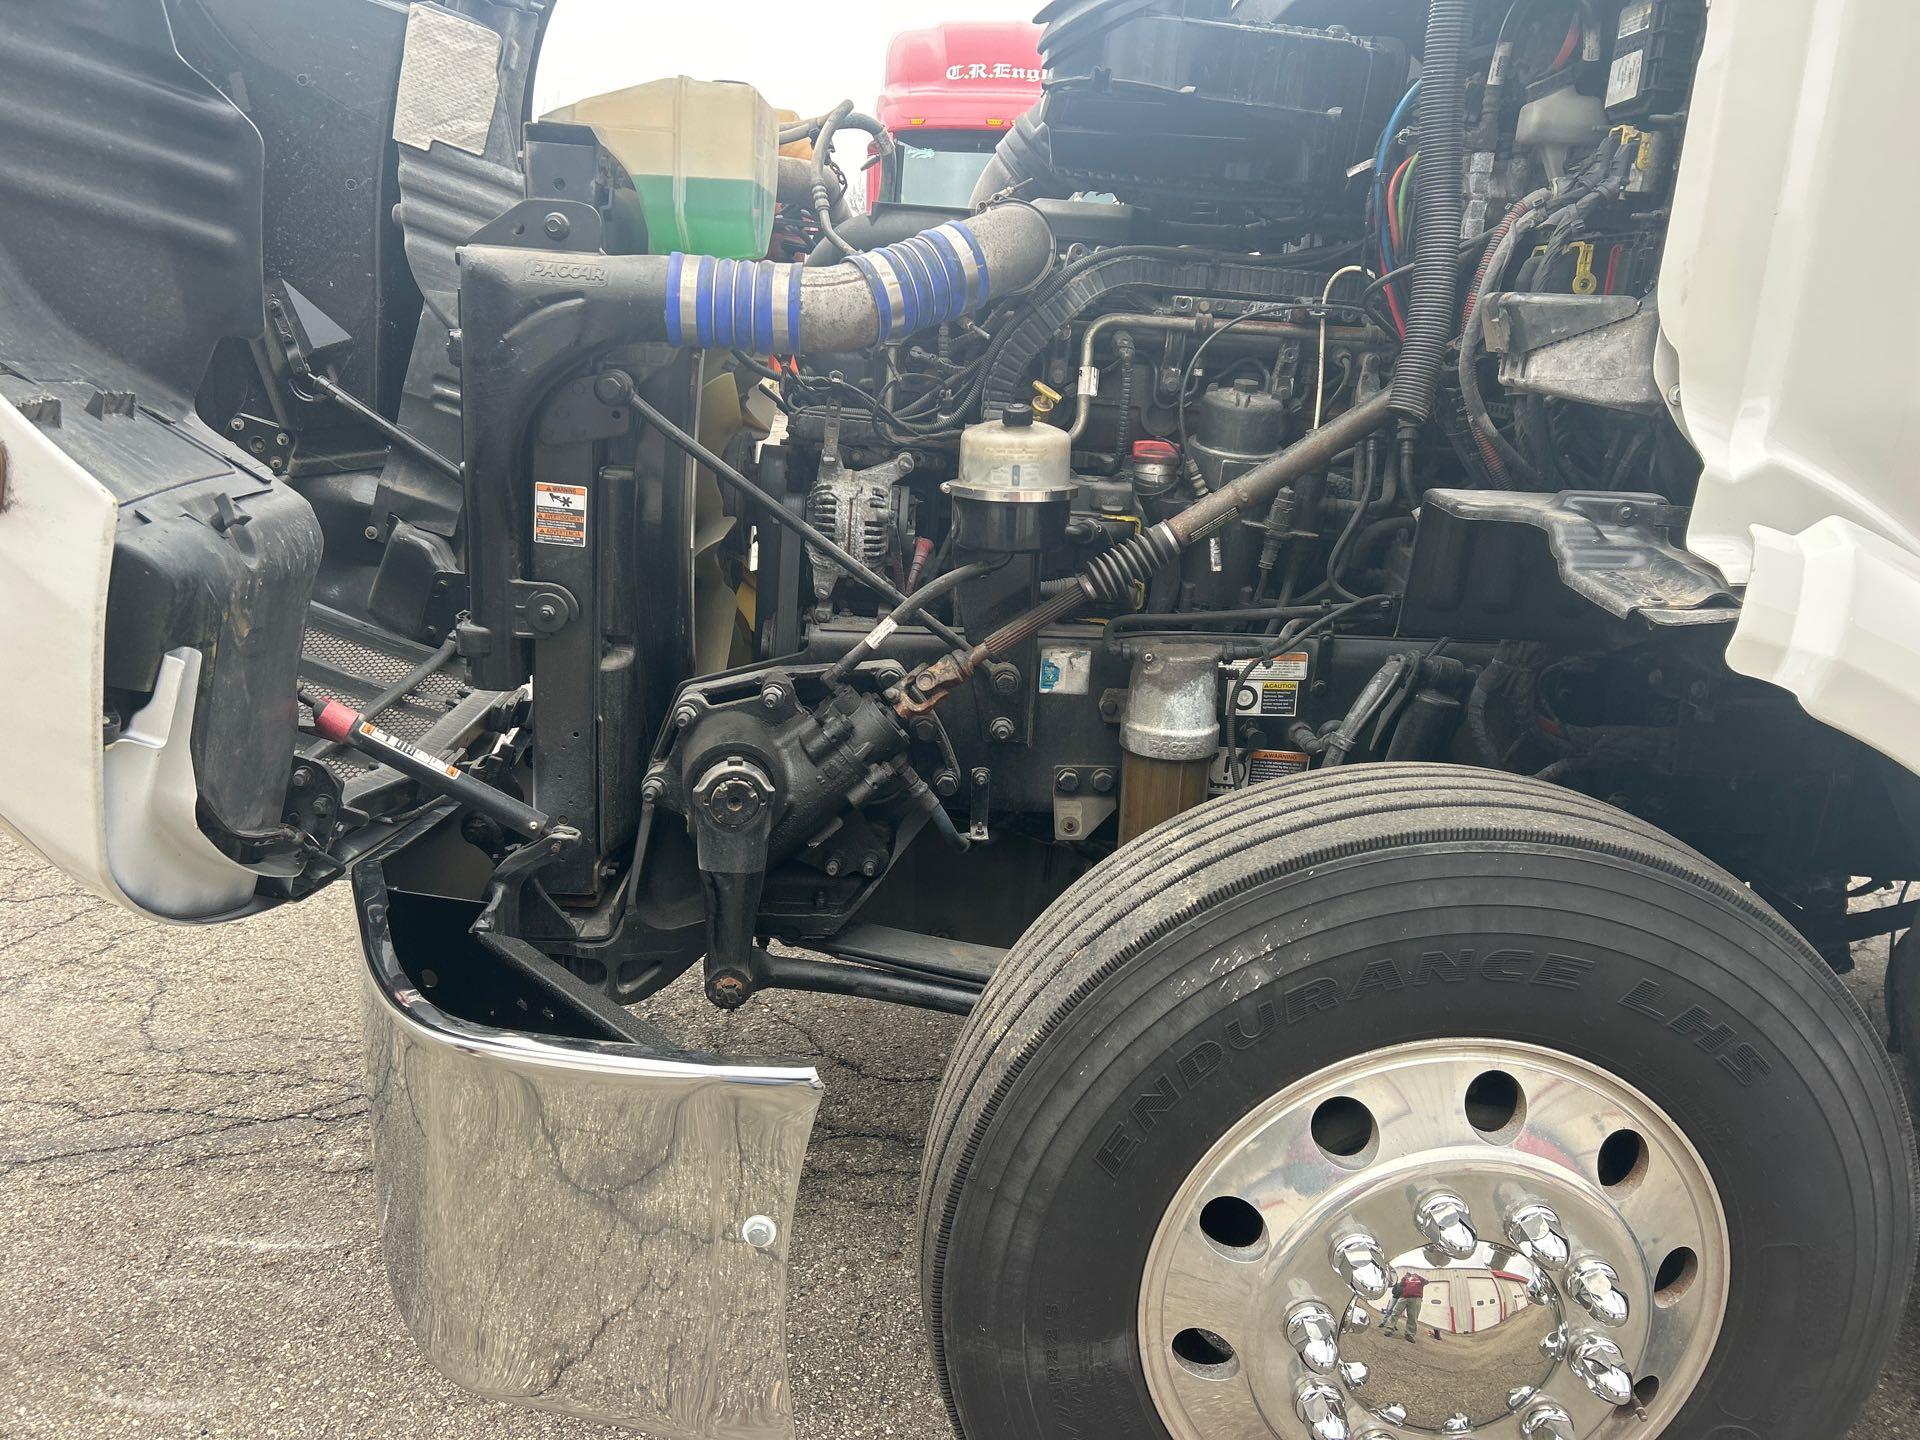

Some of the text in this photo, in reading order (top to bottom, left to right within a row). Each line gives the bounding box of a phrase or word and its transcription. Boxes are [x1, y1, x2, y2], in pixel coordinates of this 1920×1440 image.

[530, 263, 605, 281] PACCAR
[1093, 948, 1597, 1179] ENDURANCE
[1617, 978, 1773, 1086] LHS
